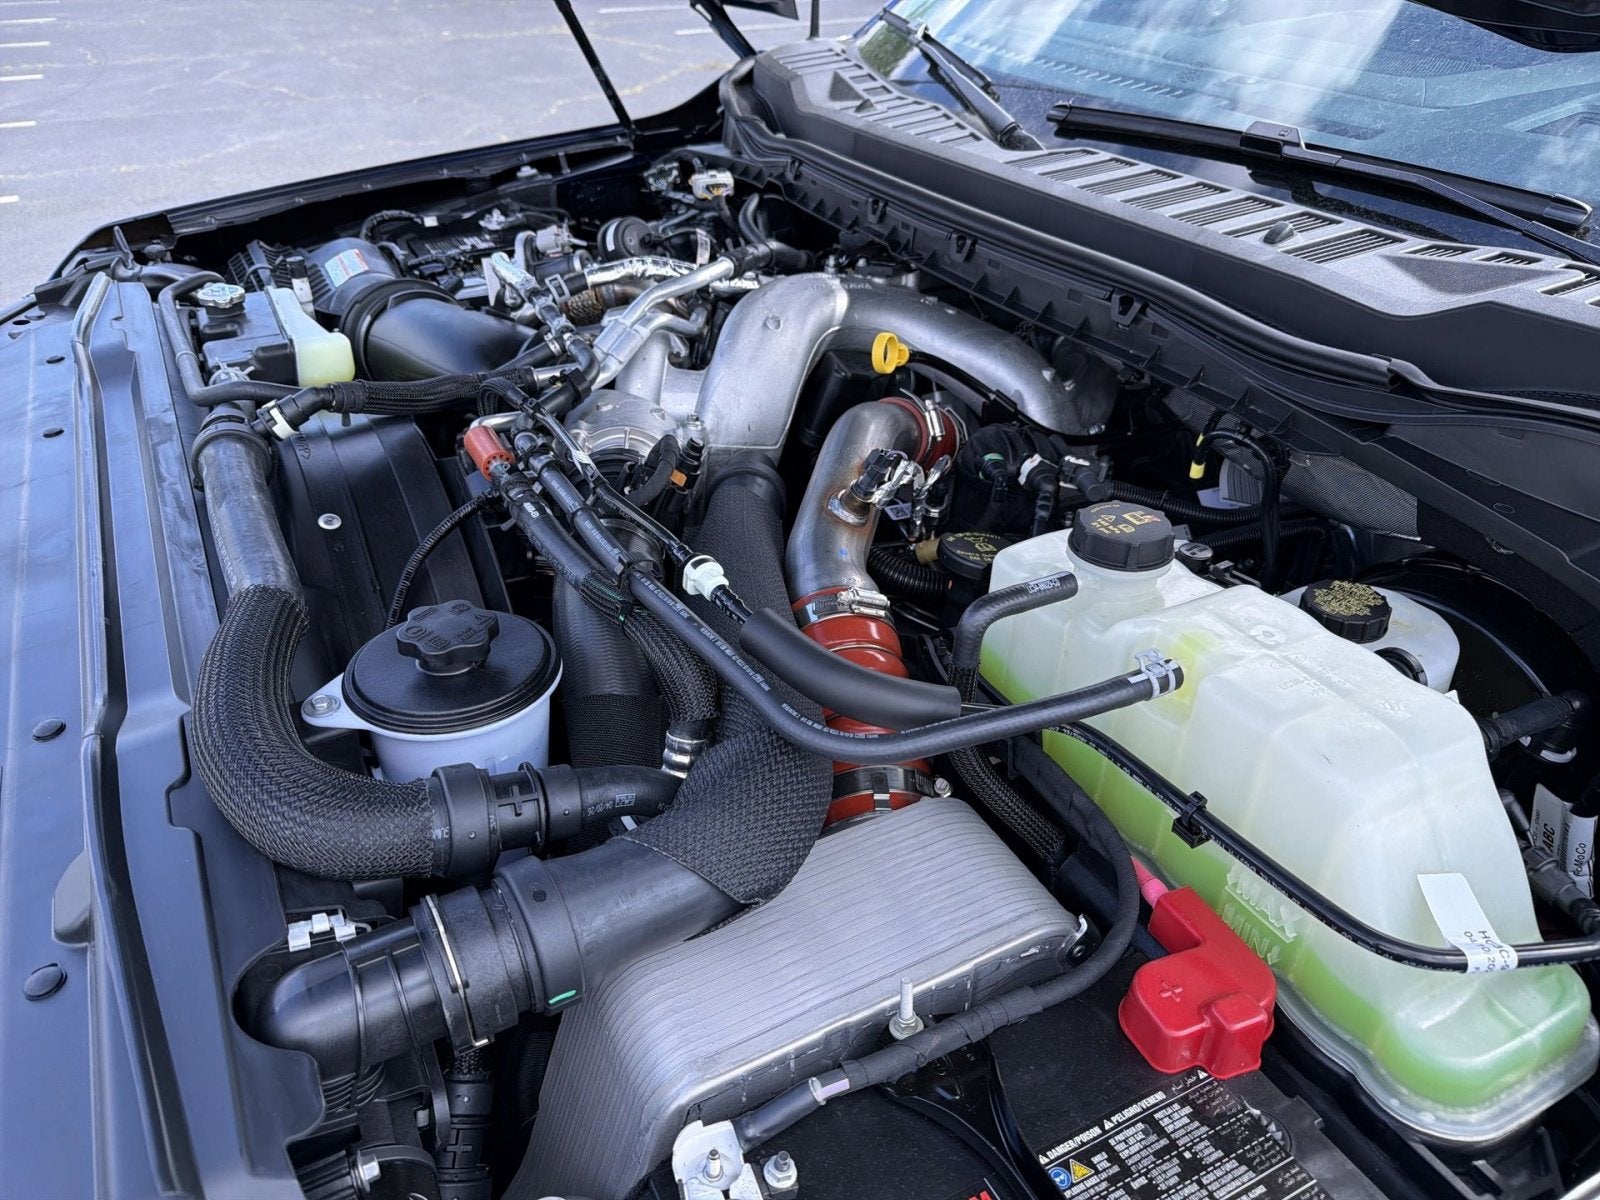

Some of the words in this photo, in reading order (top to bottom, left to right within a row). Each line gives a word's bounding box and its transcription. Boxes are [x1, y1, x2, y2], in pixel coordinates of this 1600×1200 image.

[1543, 824, 1555, 853] ABC
[1236, 868, 1303, 938] MAX
[1110, 1091, 1166, 1125] PELIGRO/VENENO
[1046, 1126, 1102, 1160] DANGER/POISON
